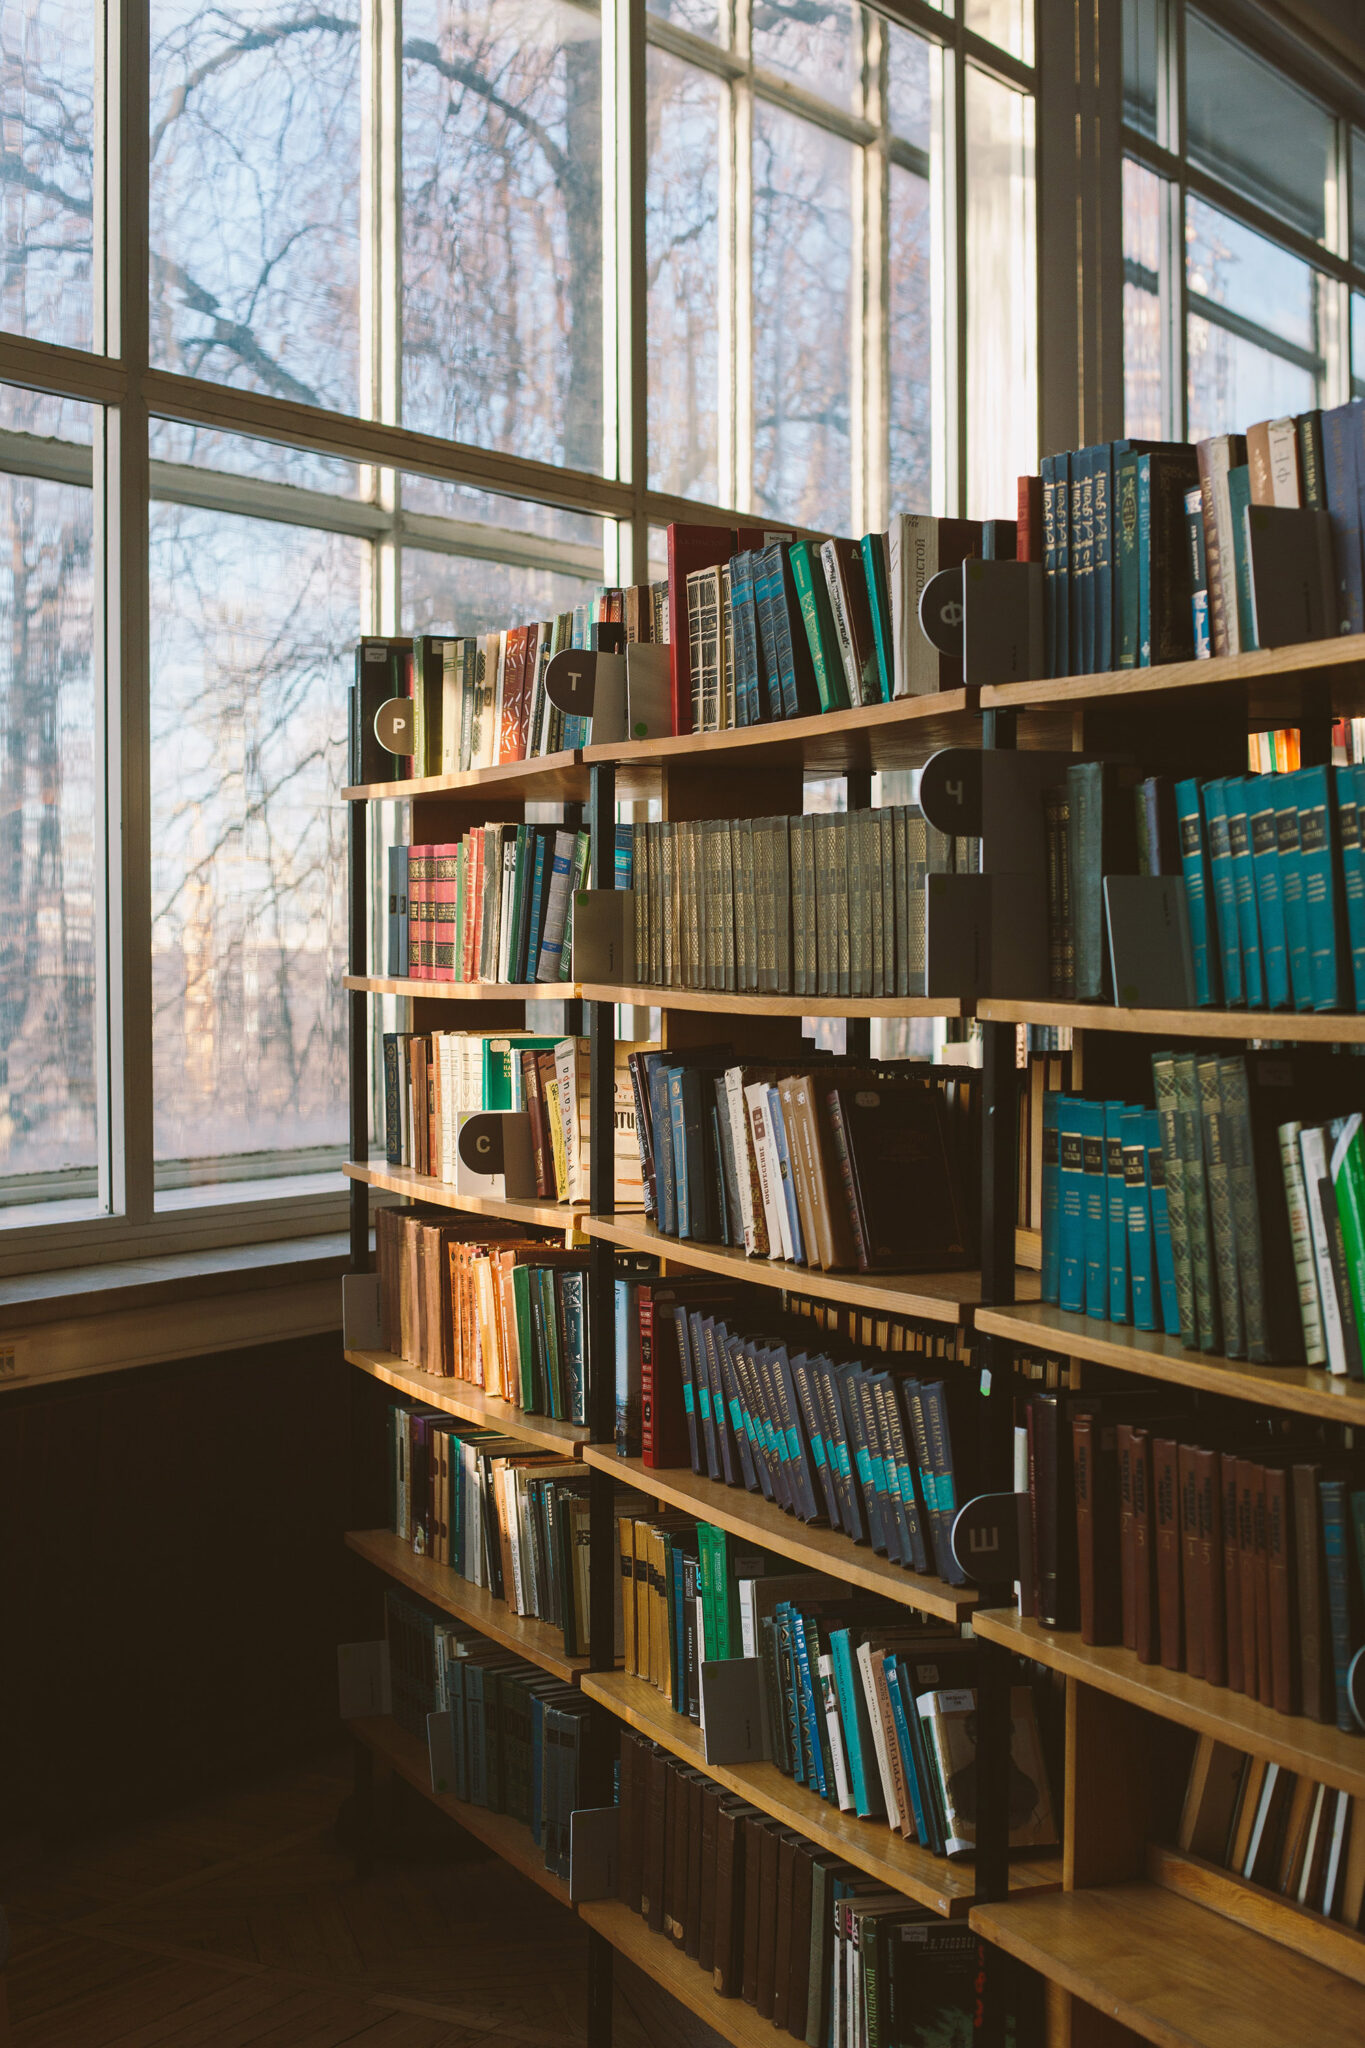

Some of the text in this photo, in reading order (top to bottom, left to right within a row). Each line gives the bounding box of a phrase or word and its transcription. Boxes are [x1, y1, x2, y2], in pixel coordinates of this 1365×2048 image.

[568, 672, 581, 691] Т
[393, 718, 406, 734] Р
[946, 780, 963, 805] Ч
[475, 1135, 491, 1153] С
[909, 1520, 917, 1534] 6
